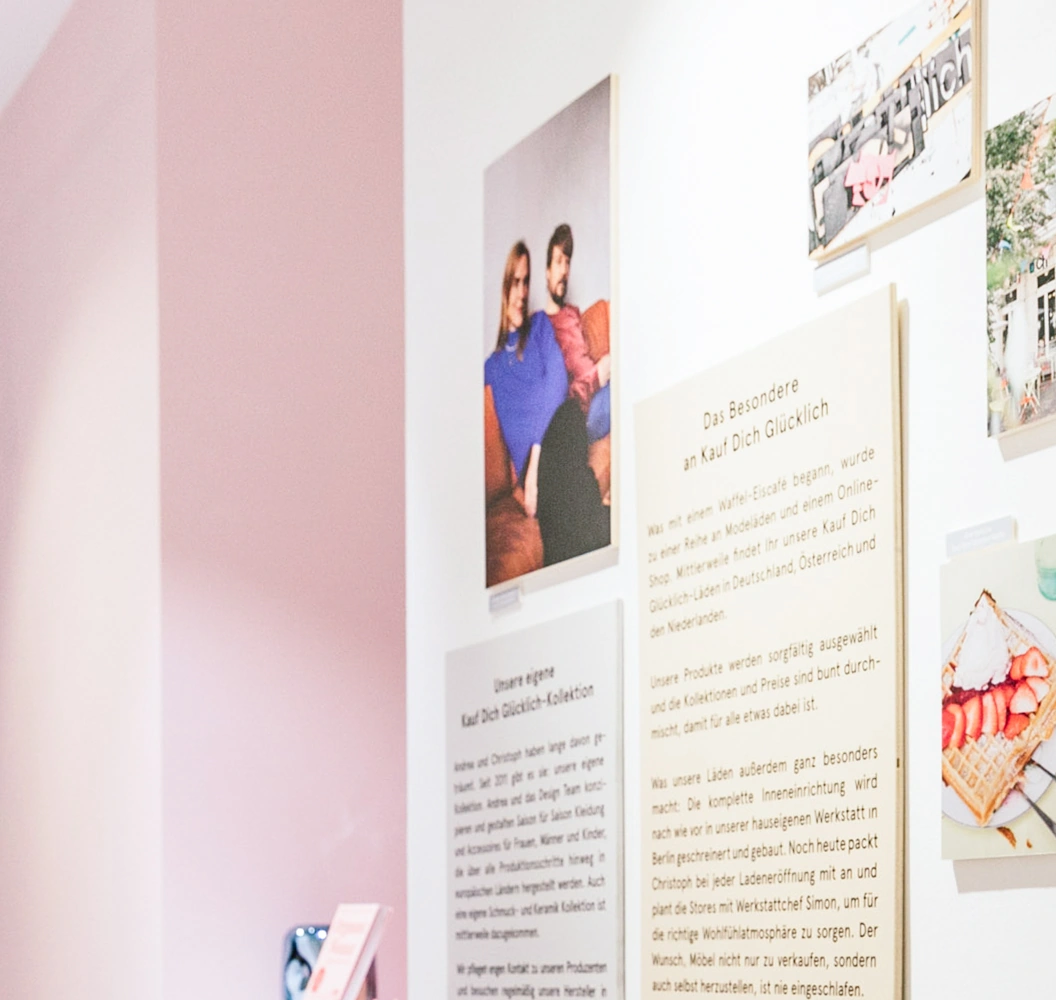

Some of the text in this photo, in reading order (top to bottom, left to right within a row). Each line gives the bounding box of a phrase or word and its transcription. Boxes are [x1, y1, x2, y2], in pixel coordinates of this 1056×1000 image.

[703, 378, 799, 431] Das Besondere
[683, 398, 829, 472] an Kauf Dich Glücklich
[683, 662, 724, 682] Produkte
[728, 653, 763, 672] werden
[768, 639, 814, 665] sorgfältig
[819, 624, 878, 653] ausgewählt
[650, 699, 667, 715] und
[683, 687, 738, 707] Kollektionen
[740, 679, 758, 697] und
[760, 675, 791, 692] Preise
[793, 667, 814, 686] sind
[816, 662, 841, 681] bunt
[843, 654, 881, 676] durch-
[672, 773, 702, 788] unsere
[706, 767, 734, 783] Läden
[739, 759, 788, 779] außerdem
[793, 756, 817, 775] ganz
[822, 745, 879, 767] besonders
[687, 796, 702, 812] Die
[708, 791, 754, 810] komplette
[761, 780, 846, 802] Inneneinrichtung
[854, 772, 878, 791] wird
[651, 861, 878, 892] Christoph bei jeder Ladeneröffnung mit an und
[667, 928, 700, 945] richtige
[702, 924, 798, 943] Wohlfühlatmosphäre
[800, 927, 813, 940] zu
[816, 926, 855, 944] sorgen.
[858, 921, 879, 939] Der
[673, 978, 699, 993] selbst
[700, 979, 757, 996] herzustellen,
[759, 979, 772, 995] ist
[773, 979, 789, 996] nie
[790, 979, 865, 1000] eingeschlafen.
